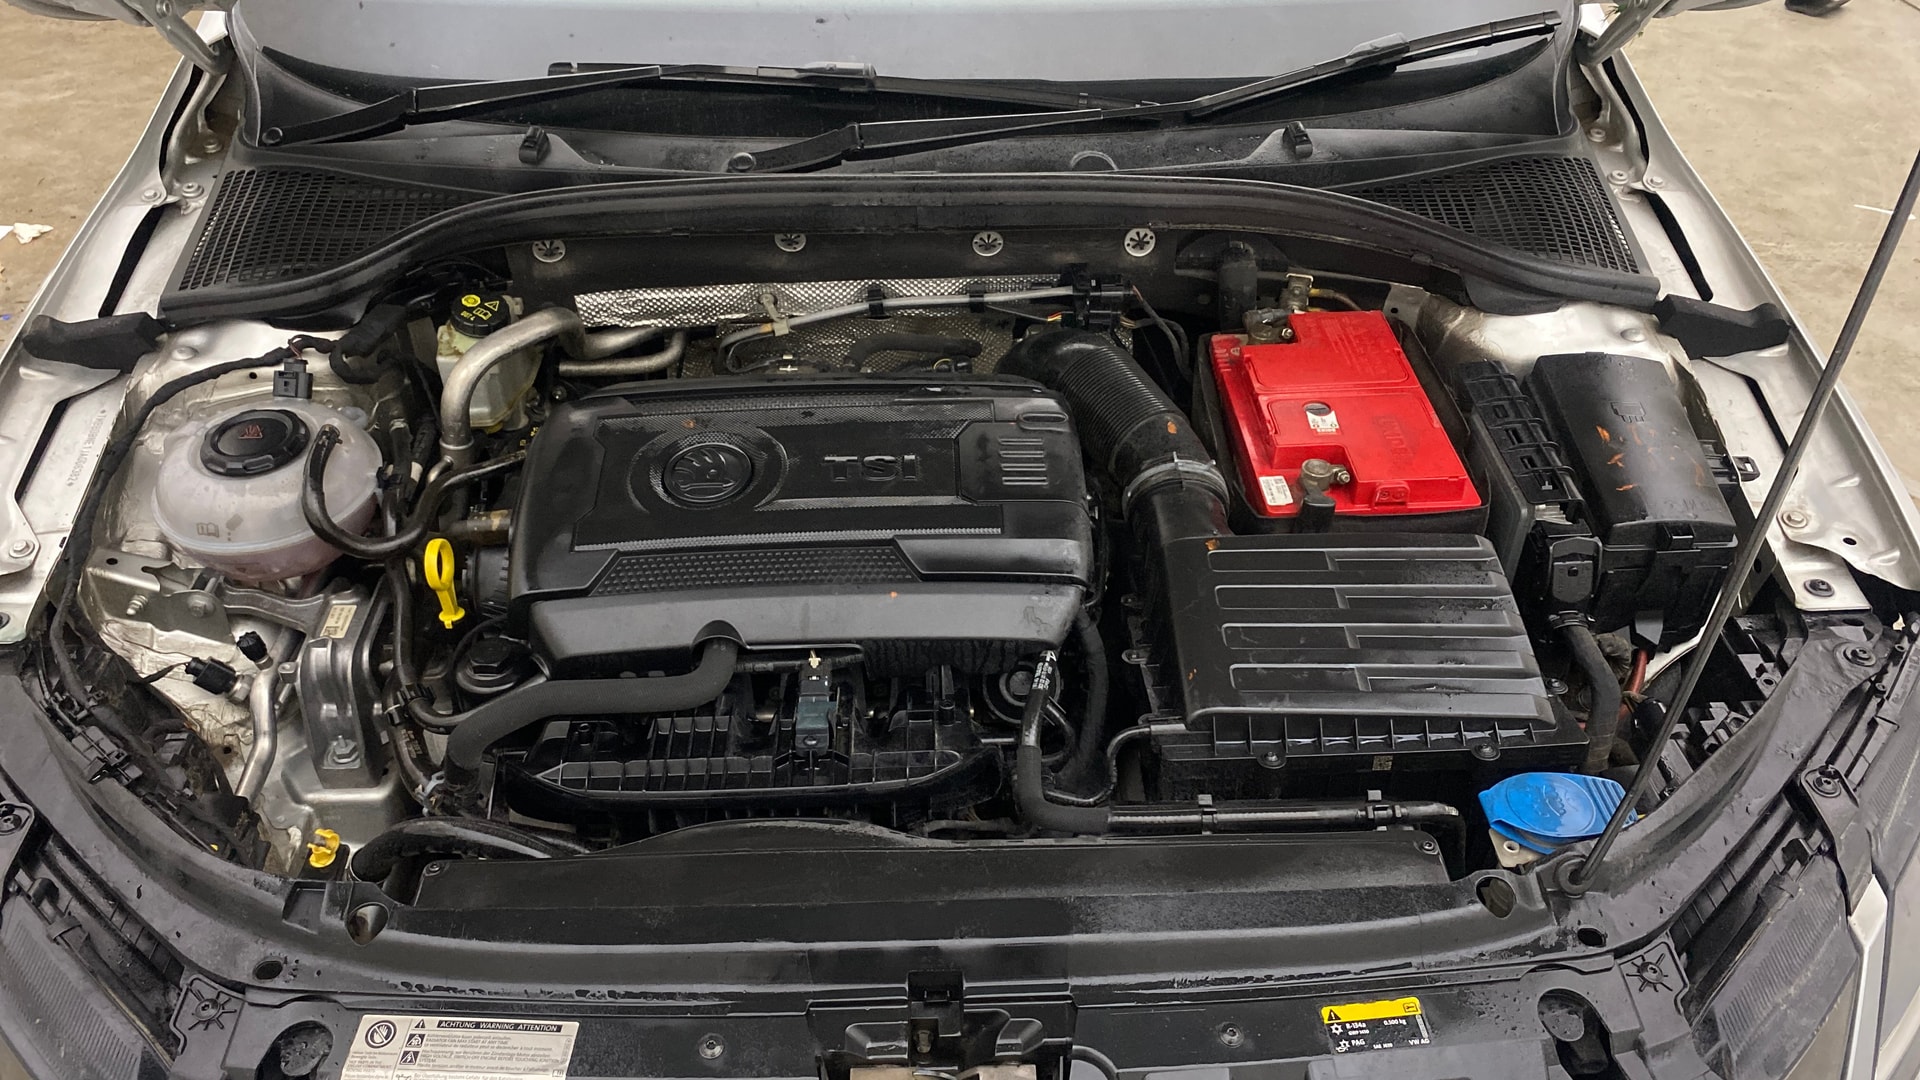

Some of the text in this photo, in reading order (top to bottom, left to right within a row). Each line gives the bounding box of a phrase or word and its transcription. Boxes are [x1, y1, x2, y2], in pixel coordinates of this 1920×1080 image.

[823, 454, 917, 481] TSI
[440, 1021, 558, 1031] ACHTUNG WARNING ATTENTION
